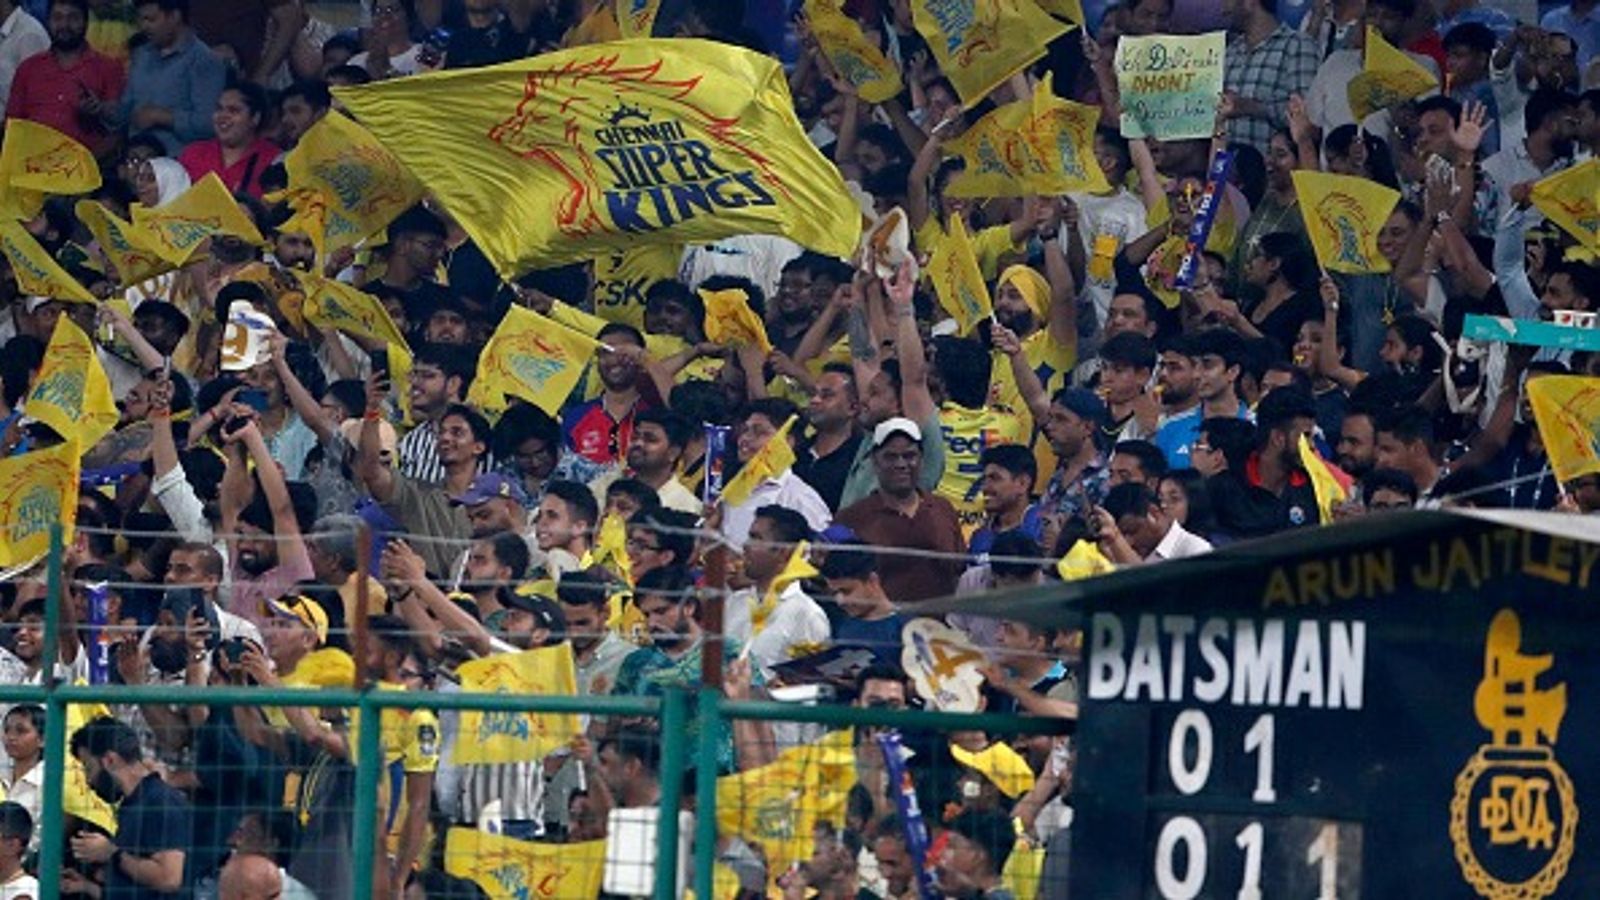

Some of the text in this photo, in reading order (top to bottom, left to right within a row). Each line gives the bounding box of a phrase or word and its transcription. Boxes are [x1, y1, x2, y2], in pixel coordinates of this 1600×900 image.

[594, 119, 686, 146] CHENNAI
[595, 139, 731, 189] SUPER
[602, 170, 776, 234] KINGS
[1261, 527, 1600, 608] ARUN JAITLEY
[1087, 611, 1367, 710] BATSMAN
